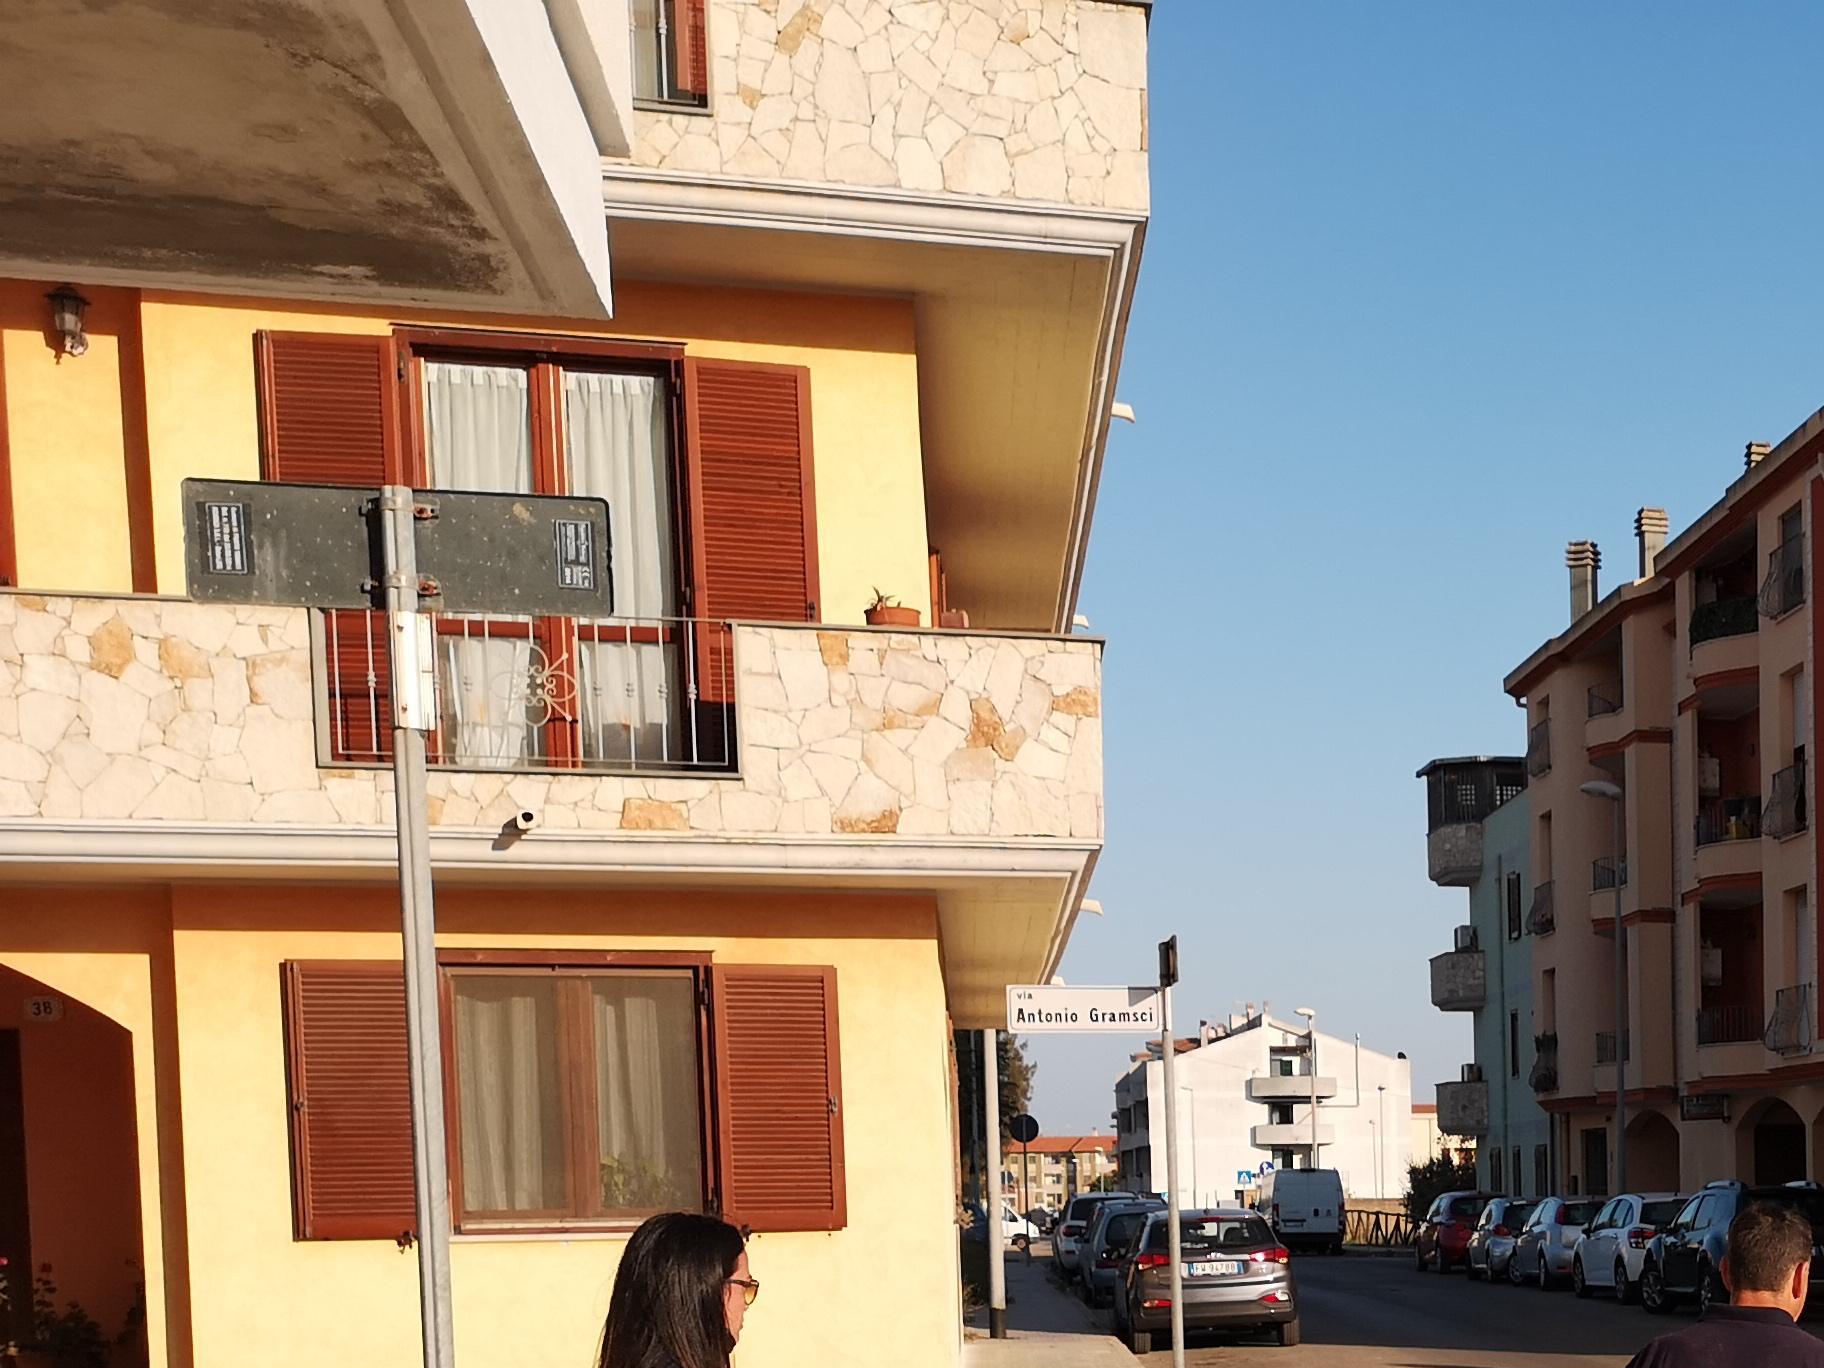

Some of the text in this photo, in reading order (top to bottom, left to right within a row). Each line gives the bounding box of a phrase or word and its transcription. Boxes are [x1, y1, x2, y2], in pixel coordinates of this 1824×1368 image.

[1016, 991, 1033, 1000] via
[1016, 1007, 1153, 1023] Antonio Gramsci
